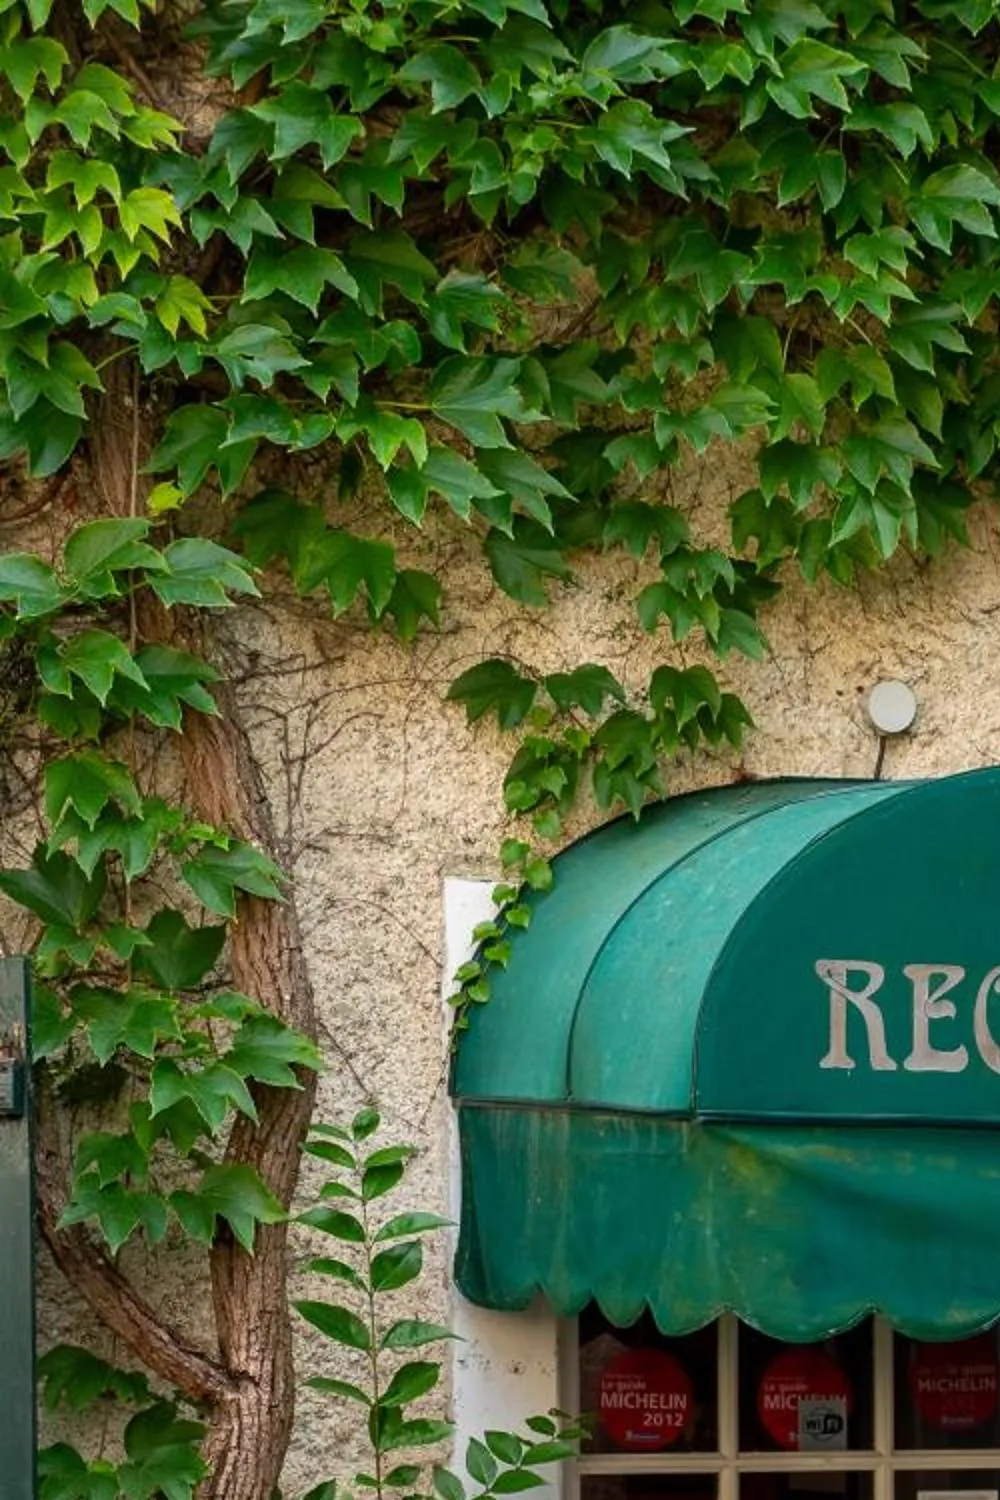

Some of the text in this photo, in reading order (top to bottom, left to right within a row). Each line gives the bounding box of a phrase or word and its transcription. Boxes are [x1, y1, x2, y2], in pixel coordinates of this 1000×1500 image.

[917, 1376, 997, 1393] MICHELIN
[600, 1391, 687, 1409] MICHELIN
[643, 1412, 684, 1427] 2012
